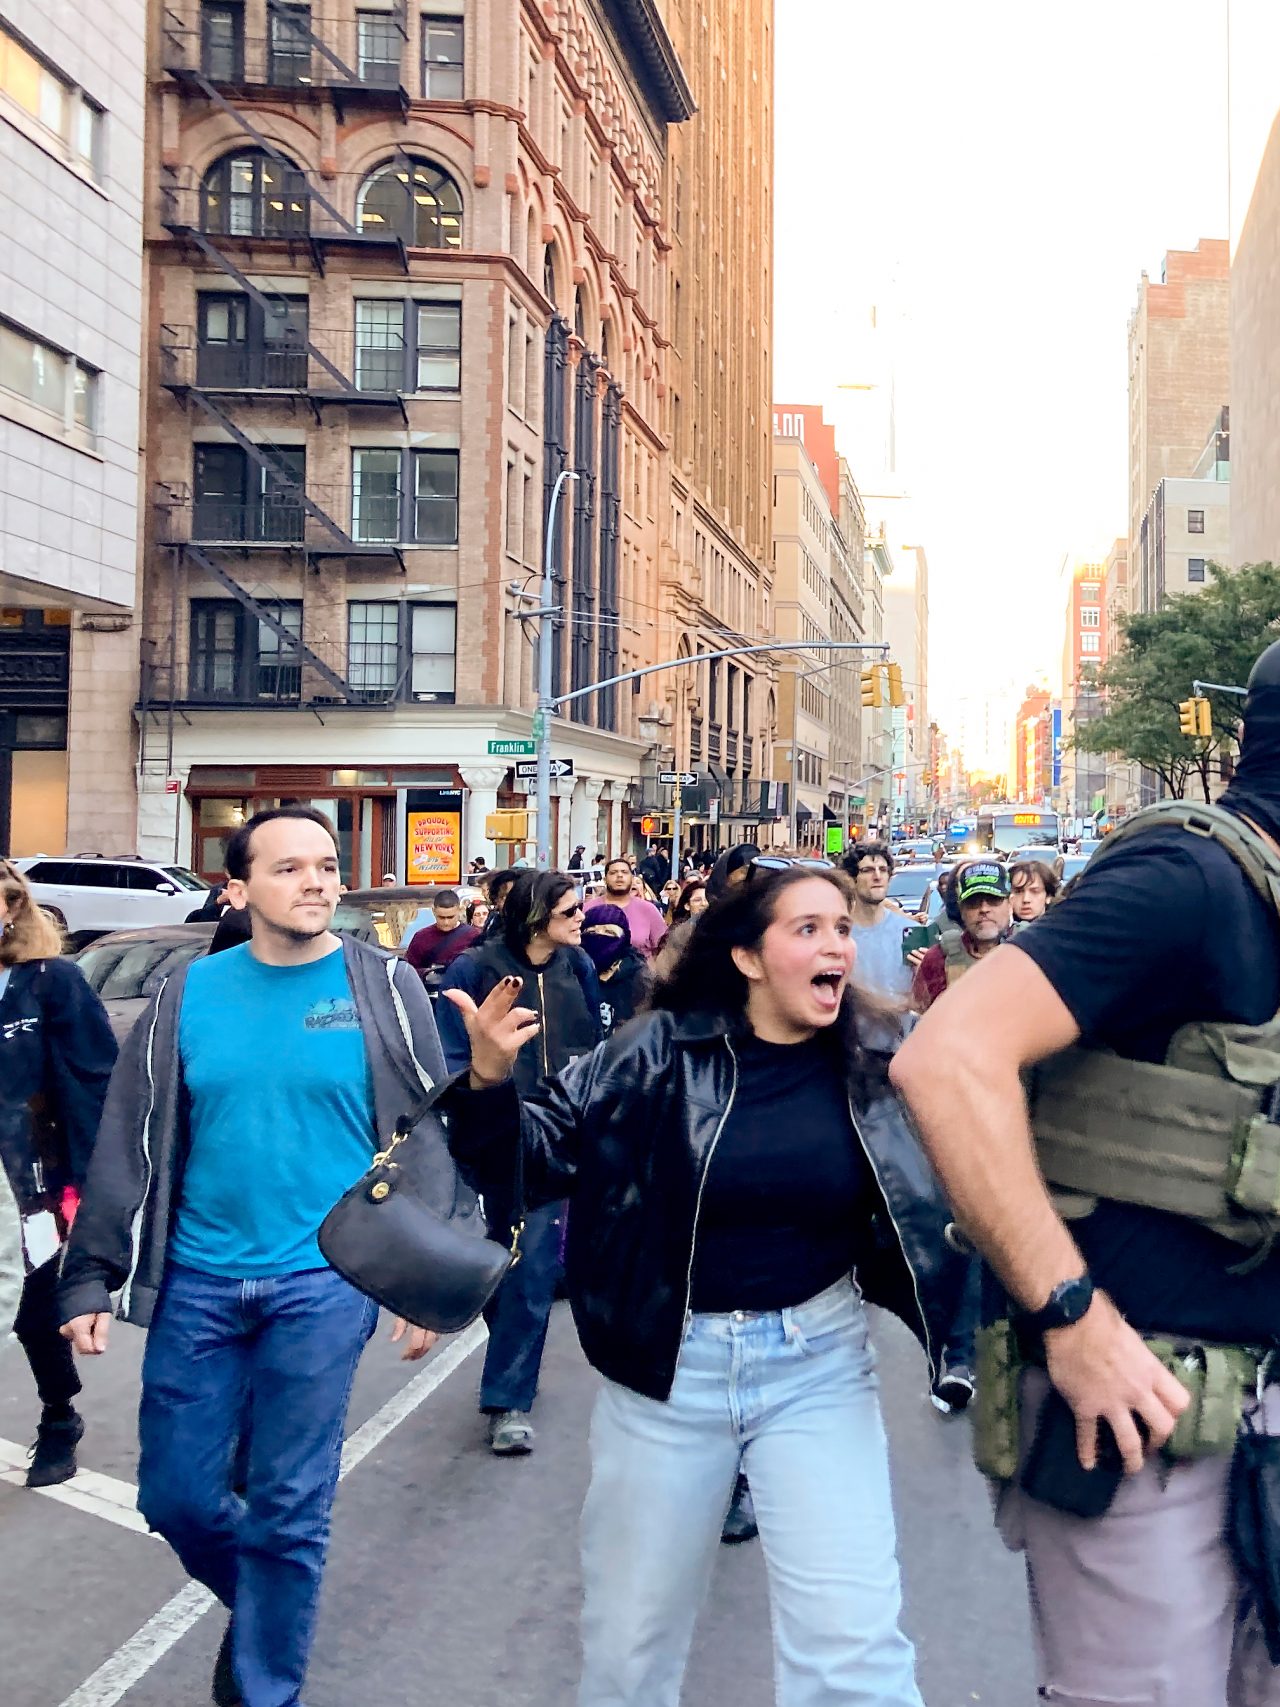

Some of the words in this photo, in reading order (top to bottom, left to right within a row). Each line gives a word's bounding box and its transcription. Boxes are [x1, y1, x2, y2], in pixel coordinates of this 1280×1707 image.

[491, 741, 525, 753] Franklin
[521, 765, 538, 773] ONE
[549, 764, 562, 772] AY
[418, 817, 449, 826] PROUDLY
[415, 828, 454, 836] SUPPORTING
[414, 844, 433, 853] NEW
